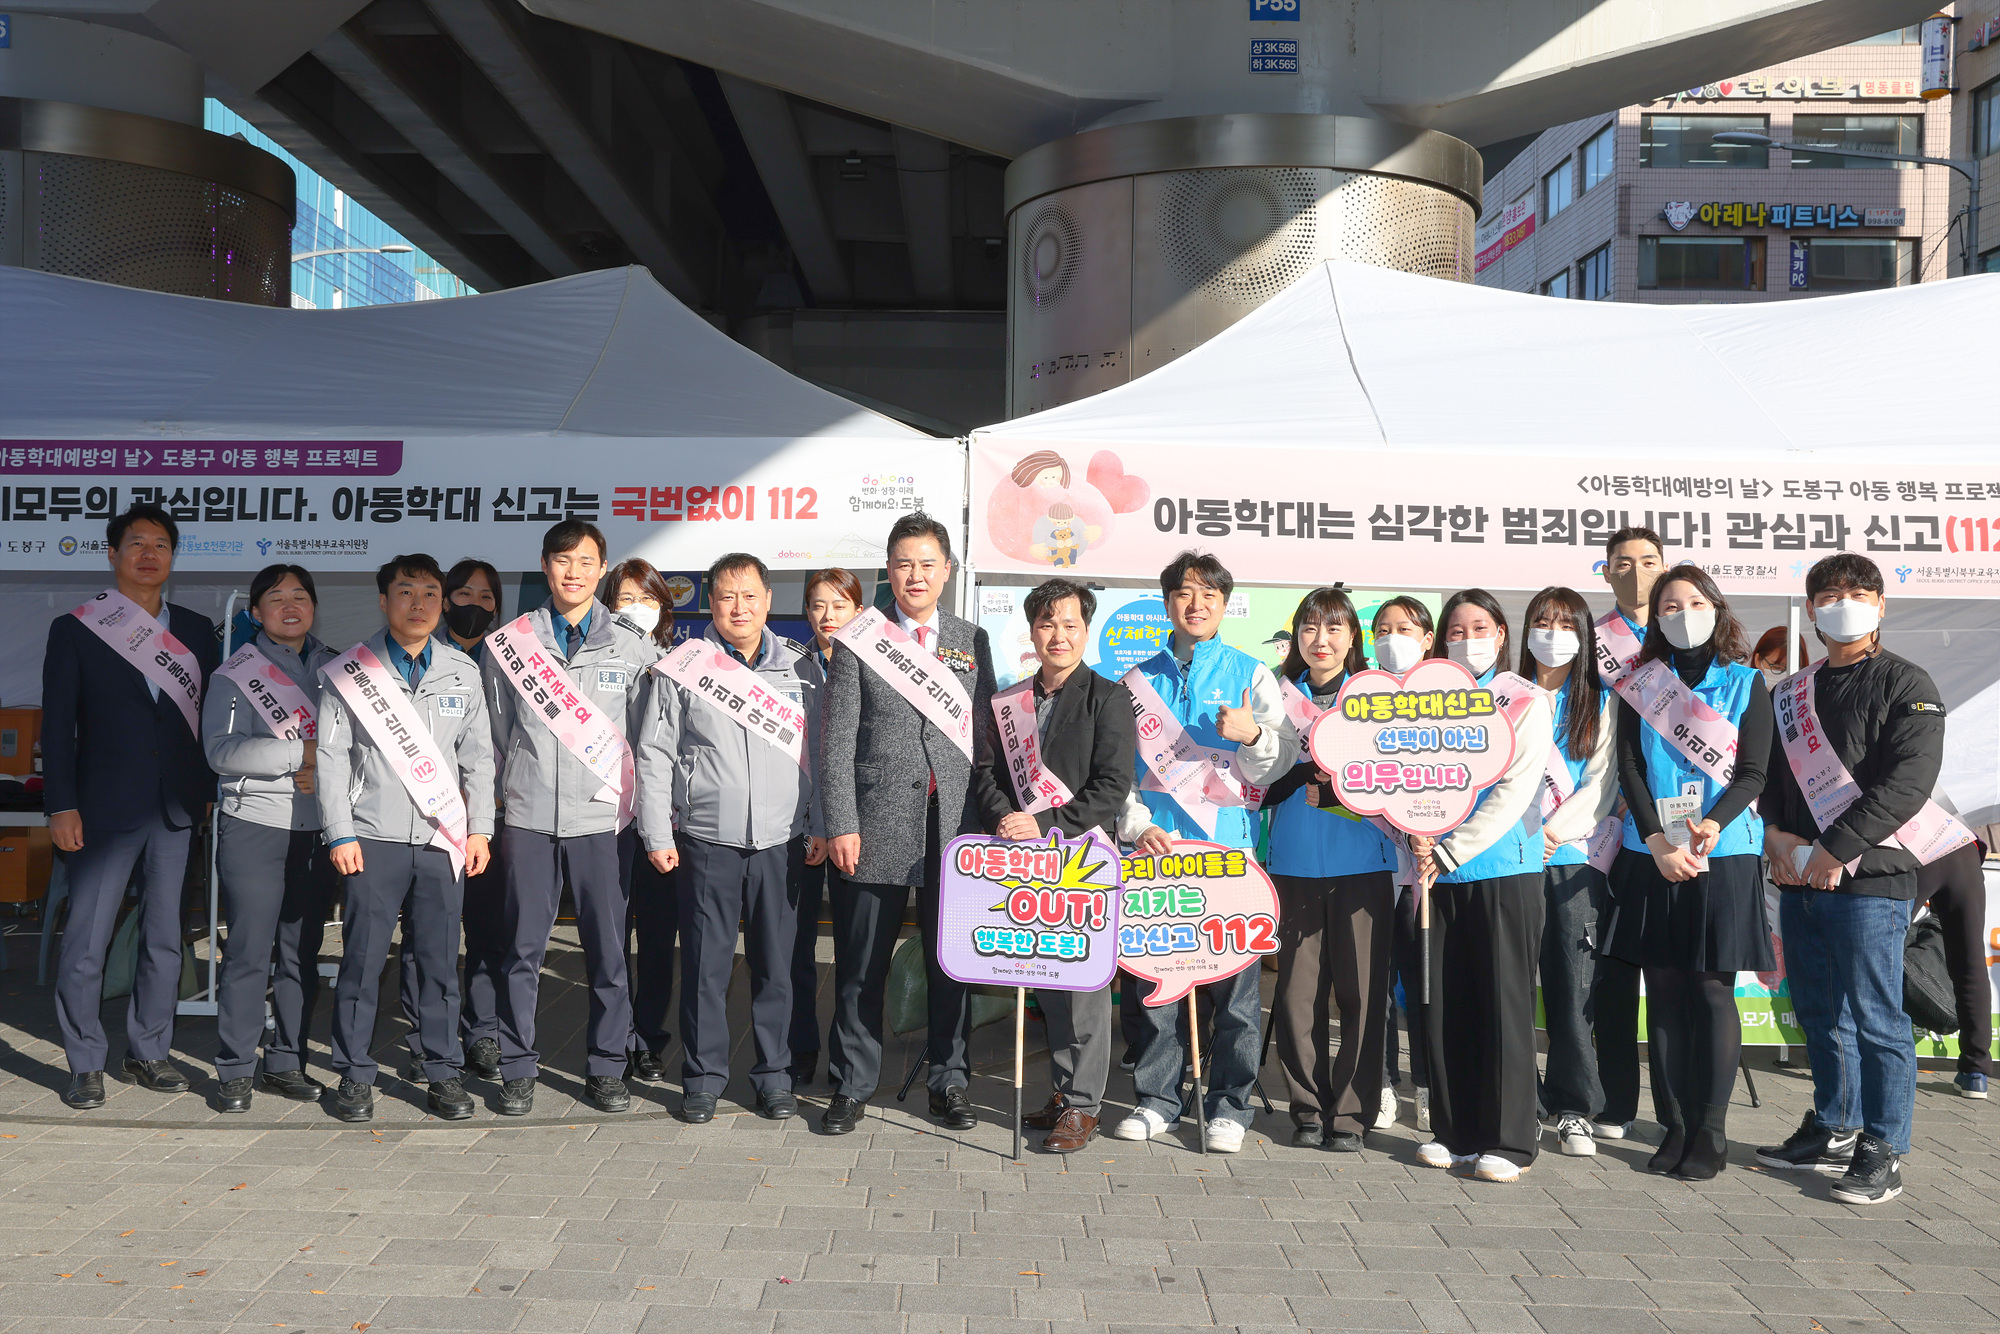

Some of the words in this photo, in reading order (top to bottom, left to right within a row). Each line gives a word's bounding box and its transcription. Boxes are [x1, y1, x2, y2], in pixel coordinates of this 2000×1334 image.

[1255, 0, 1297, 11] P55
[1253, 42, 1263, 54] 상
[1264, 43, 1296, 53] 3K568
[1252, 58, 1263, 70] 하
[1264, 59, 1296, 69] 3K565
[1699, 202, 1767, 228] 아레나
[1770, 203, 1860, 229] 피트니스
[161, 448, 216, 468] 도봉구
[221, 448, 258, 468] 아동
[264, 448, 300, 468] 행복
[305, 448, 379, 468] 프로젝트
[862, 474, 914, 487] dobong
[1782, 478, 1844, 500] 도봉구
[1849, 479, 1889, 502] 아동
[1896, 480, 1938, 502] 행복
[130, 486, 318, 523] 관심입니다.
[331, 486, 482, 523] 아동학대
[491, 486, 600, 522] 신고는
[611, 485, 755, 522] 국번없이
[767, 486, 819, 520] 112
[900, 496, 925, 512] 도봉
[1153, 496, 1356, 540] 아동학대는
[1367, 503, 1489, 544] 심각한
[1726, 511, 1851, 551] 관심과
[8, 540, 46, 553] 도봉구
[275, 539, 369, 550] 서울특별시북부교육지원청
[777, 549, 813, 560] dobong
[1702, 564, 1777, 576] 서울도봉경찰서
[1116, 613, 1145, 622] 아동학대
[494, 631, 525, 674] 우리의
[527, 651, 592, 725] 지켜주세요
[600, 671, 626, 682] 경찰
[600, 682, 625, 690] POLICE
[875, 638, 929, 686] 아동학대
[926, 680, 962, 720] 신고는
[698, 676, 747, 713] 우리의
[1343, 691, 1495, 721] 아동학대신고
[343, 658, 391, 715] 아동학대
[384, 716, 421, 759] 신고는
[413, 760, 436, 781] 112
[1140, 717, 1161, 737] 112
[1795, 676, 1822, 754] 지켜주세요
[1000, 705, 1020, 753] 우리의
[1376, 727, 1438, 751] 선택이
[1443, 727, 1486, 750] 아닌
[1674, 723, 1724, 767] 우리의
[1344, 763, 1467, 790] 의무입니다
[1433, 810, 1447, 819] 도봉
[958, 846, 1060, 881] 아동학대
[1160, 851, 1247, 877] 아이들을
[1009, 890, 1103, 929] OUT!
[1126, 887, 1204, 916] 지키는
[975, 928, 1034, 953] 행복한
[1037, 931, 1086, 957] 도봉!
[1202, 916, 1277, 952] 112
[1015, 961, 1047, 970] dobong
[1175, 957, 1206, 966] dobong
[1208, 963, 1219, 971] 도봉
[1048, 971, 1060, 979] 도봉
[1740, 1011, 1776, 1028] 모가
